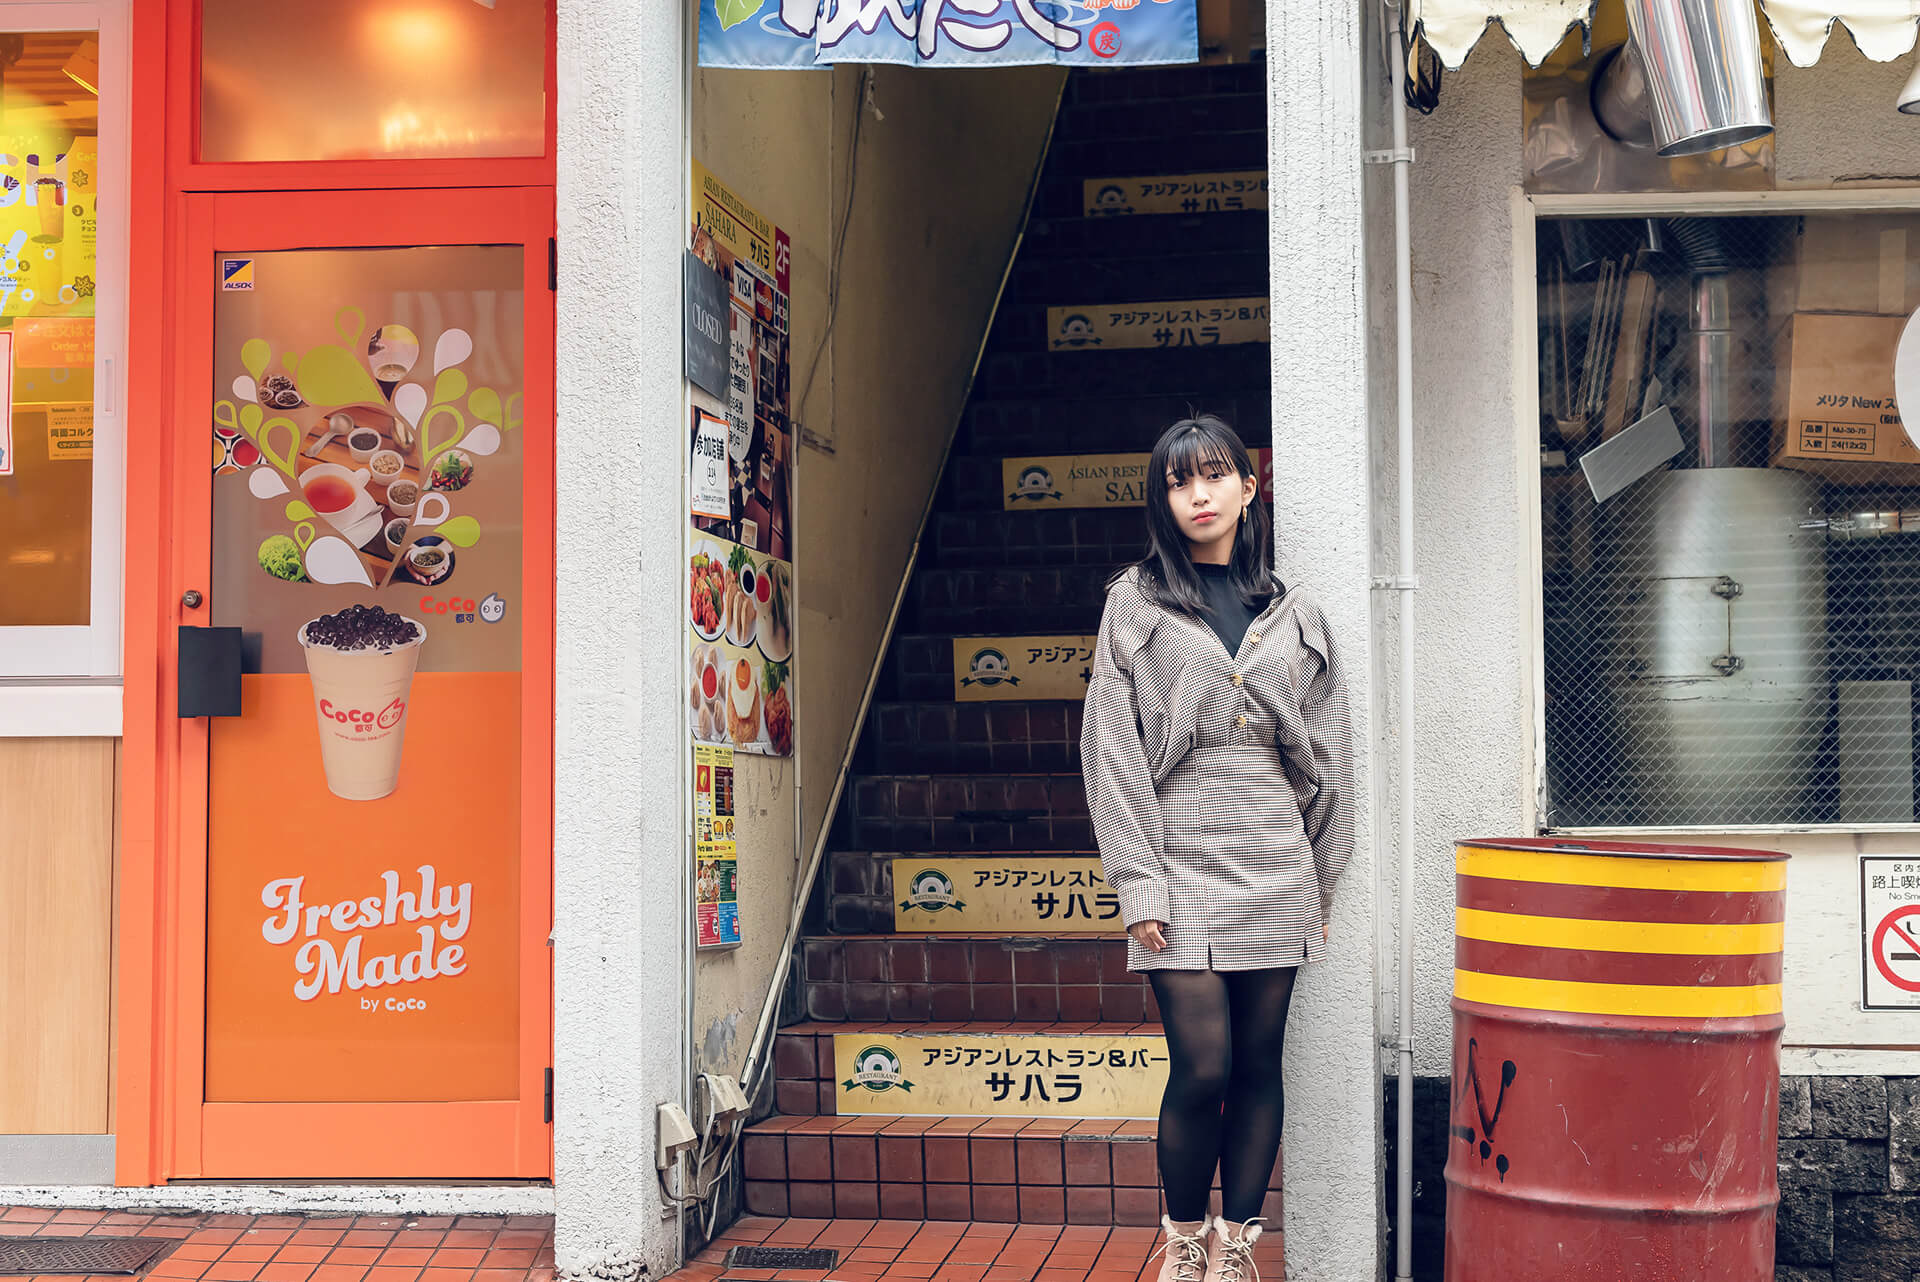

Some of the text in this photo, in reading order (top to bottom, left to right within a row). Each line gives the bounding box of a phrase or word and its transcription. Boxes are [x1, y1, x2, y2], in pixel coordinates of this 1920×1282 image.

[1098, 32, 1115, 50] 炭
[1180, 197, 1243, 211] サハラ
[705, 202, 737, 244] SAHARA
[750, 237, 770, 269] サハラ
[776, 240, 790, 275] 2F
[737, 273, 752, 301] VISA
[692, 302, 723, 345] CLOSED
[1109, 306, 1270, 326] アジアンレストラン&バ
[1153, 327, 1221, 346] サハラ
[1816, 395, 1849, 407] メリタ
[1852, 396, 1882, 409] New
[1067, 465, 1108, 479] ASIAN
[261, 864, 473, 945] Freshly
[1031, 892, 1120, 920] サハラ
[1888, 891, 1902, 900] No
[293, 925, 468, 1002] Made
[360, 996, 380, 1013] by
[922, 1047, 1169, 1068] アジアンレストラン&バー
[985, 1072, 1083, 1103] サハラ
